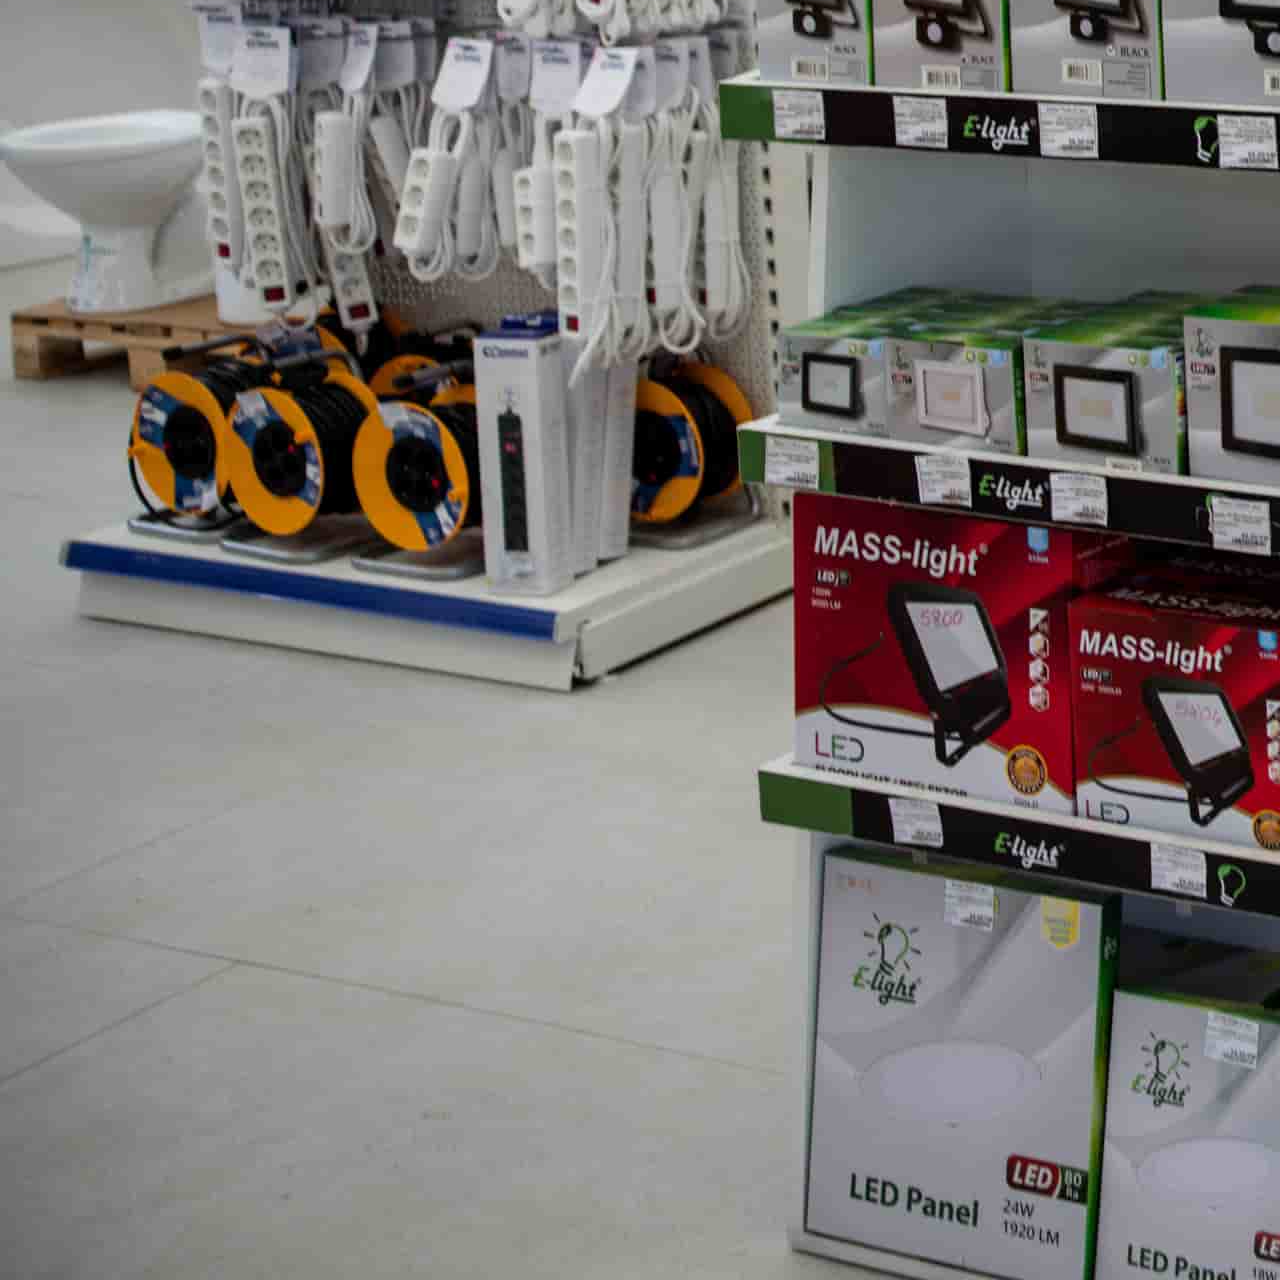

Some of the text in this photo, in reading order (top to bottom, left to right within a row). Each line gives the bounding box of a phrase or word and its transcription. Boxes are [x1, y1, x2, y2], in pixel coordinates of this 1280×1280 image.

[1120, 46, 1150, 58] BLACK
[963, 114, 1031, 152] E-light
[979, 474, 1044, 510] E-light
[814, 525, 981, 579] MASS-light
[1079, 629, 1223, 674] MASS-light
[815, 730, 865, 763] LED
[1086, 798, 1130, 825] LED
[994, 832, 1058, 870] E-light
[853, 964, 918, 1006] E-light
[1012, 1159, 1055, 1188] LED
[849, 1171, 979, 1228] LED Panel
[1003, 1199, 1035, 1218] 24W
[1003, 1220, 1060, 1247] 1920 LM
[1127, 1243, 1169, 1273] LED
